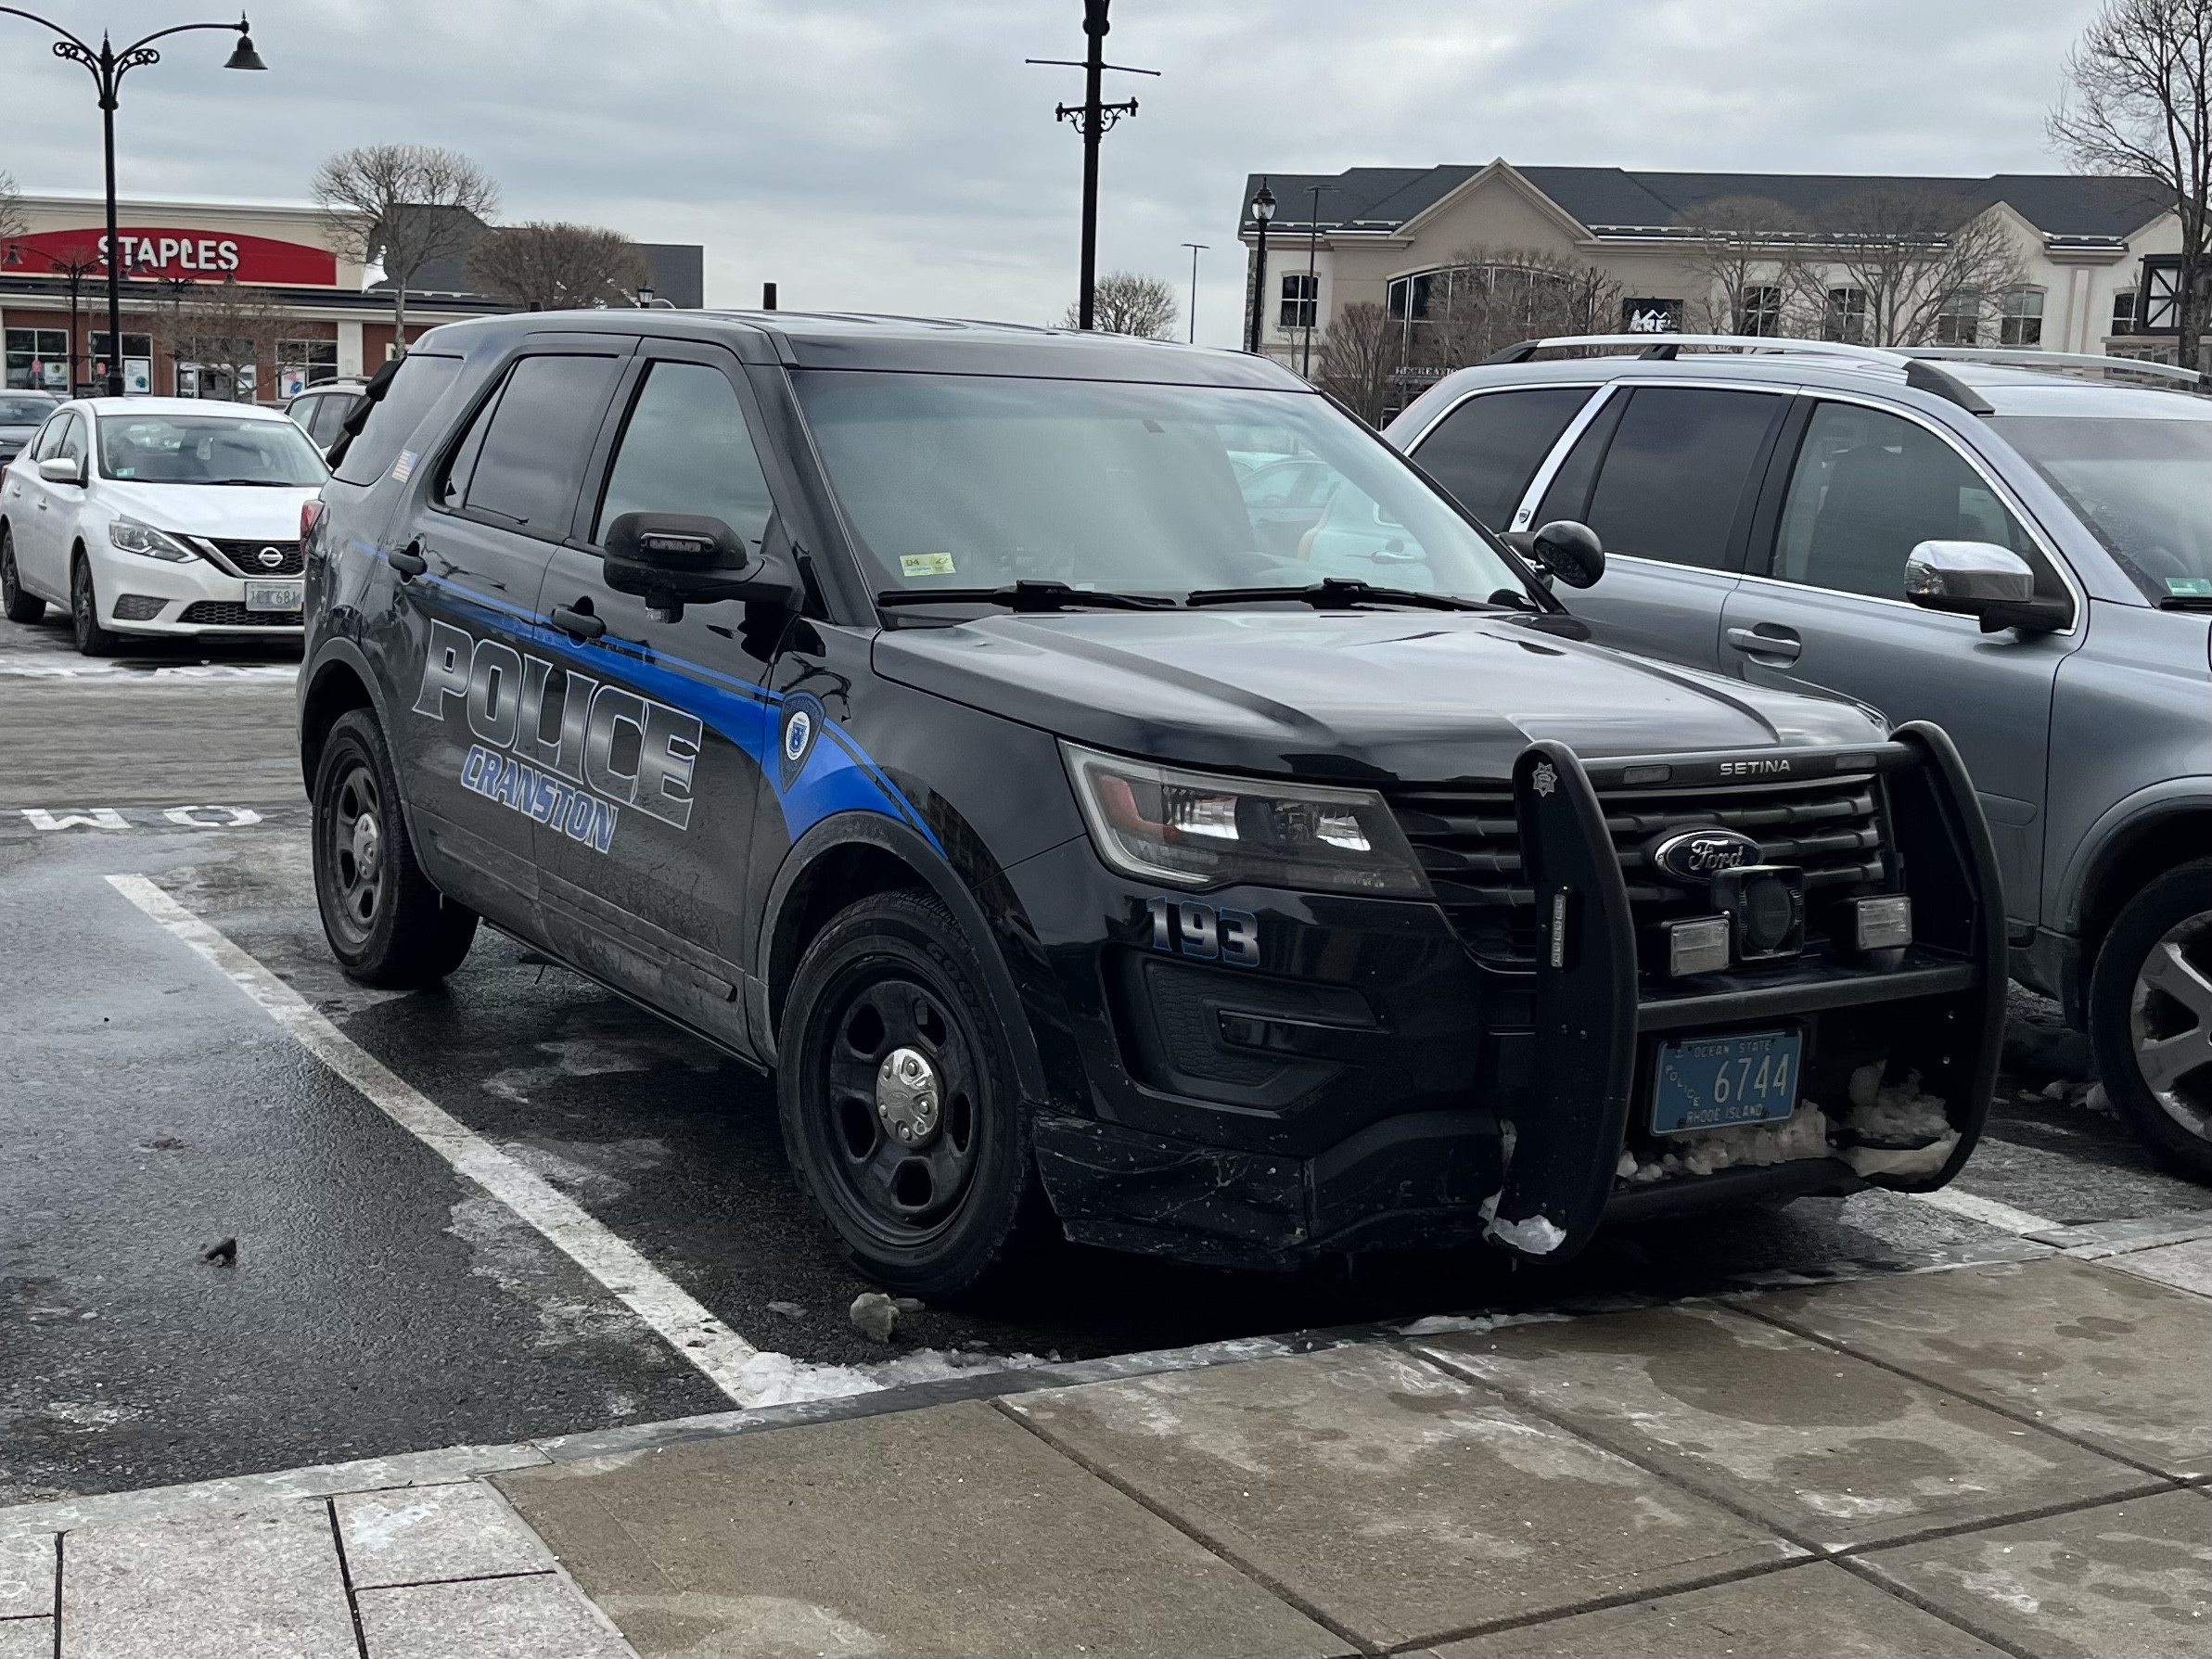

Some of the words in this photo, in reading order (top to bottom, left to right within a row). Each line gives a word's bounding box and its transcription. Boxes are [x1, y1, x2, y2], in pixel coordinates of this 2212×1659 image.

[97, 235, 239, 271] STAPLES
[412, 618, 703, 831] POLICE
[1720, 759, 1791, 776] SETINA
[460, 744, 620, 854] CRANSTON
[1688, 839, 1745, 871] Ford
[1145, 896, 1260, 968] 193
[1694, 1045, 1730, 1058] OCEAN
[1738, 1040, 1771, 1053] STATE
[1665, 1064, 1701, 1107] POLICE
[1713, 1053, 1789, 1104] 6744
[1686, 1108, 1721, 1123] RHODE
[1725, 1104, 1763, 1119] ISLAND
